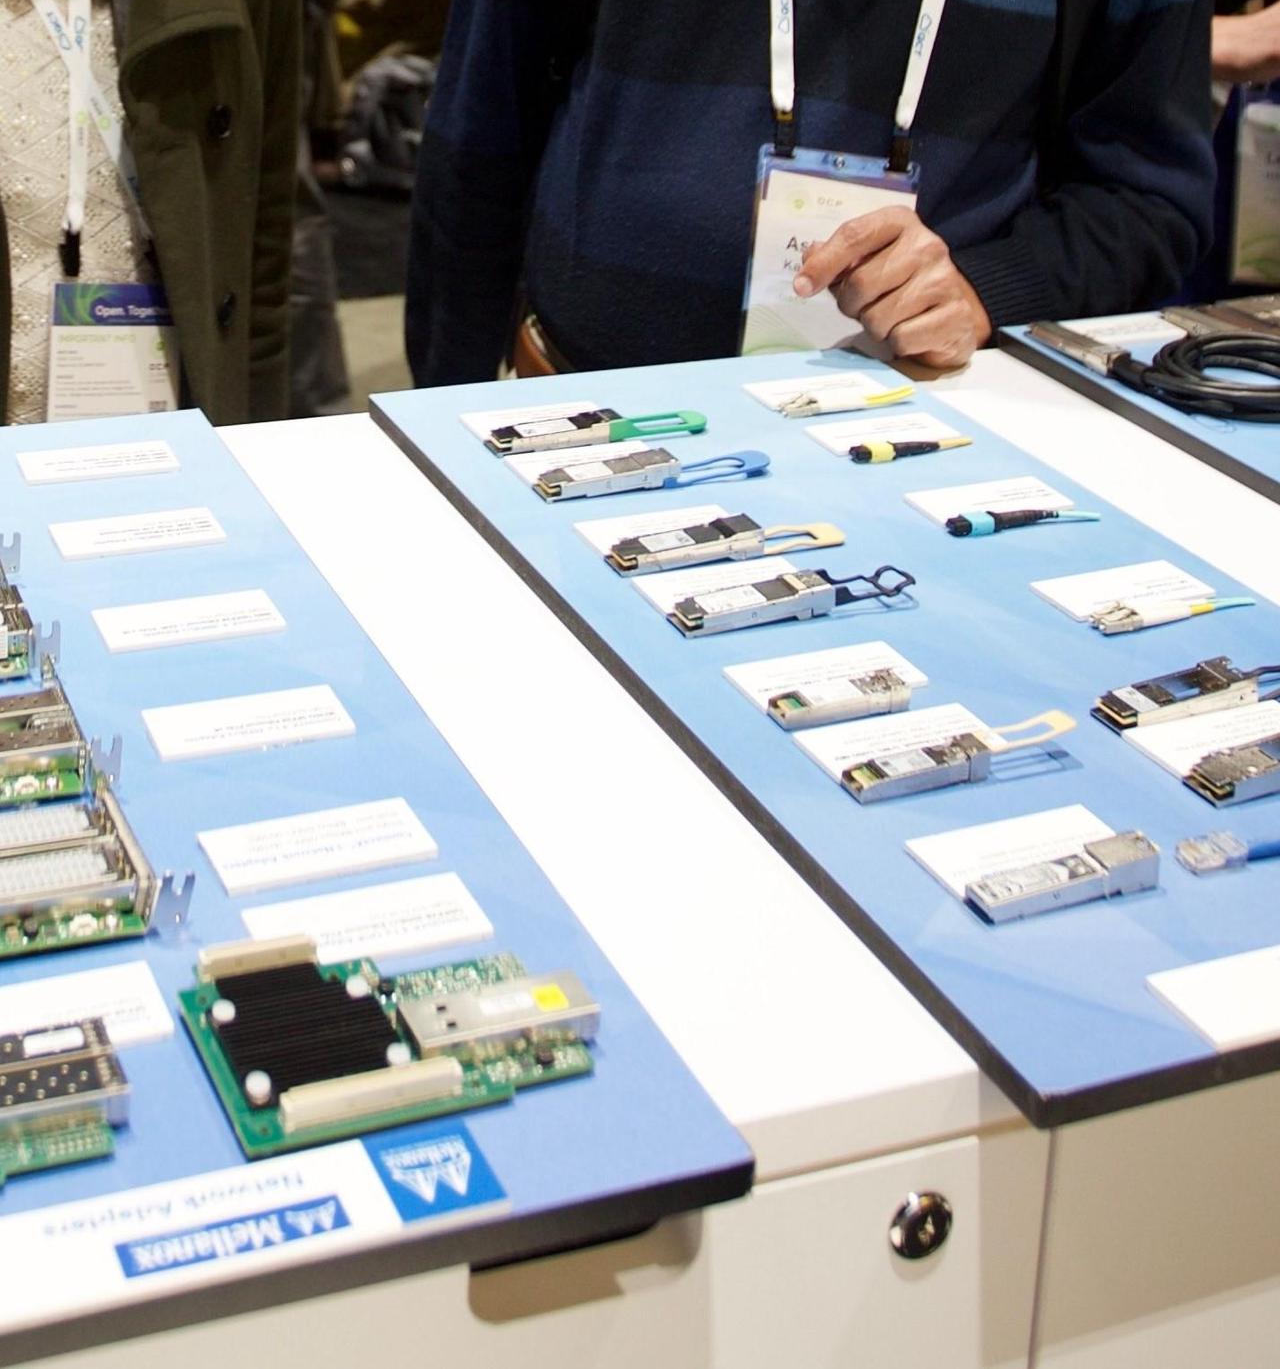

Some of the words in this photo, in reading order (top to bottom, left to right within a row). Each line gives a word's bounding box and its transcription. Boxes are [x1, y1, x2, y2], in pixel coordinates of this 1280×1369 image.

[95, 305, 125, 318] Open.
[184, 1170, 304, 1209] Network
[44, 1199, 173, 1237] Adapters
[128, 1213, 284, 1272] Mellanox
